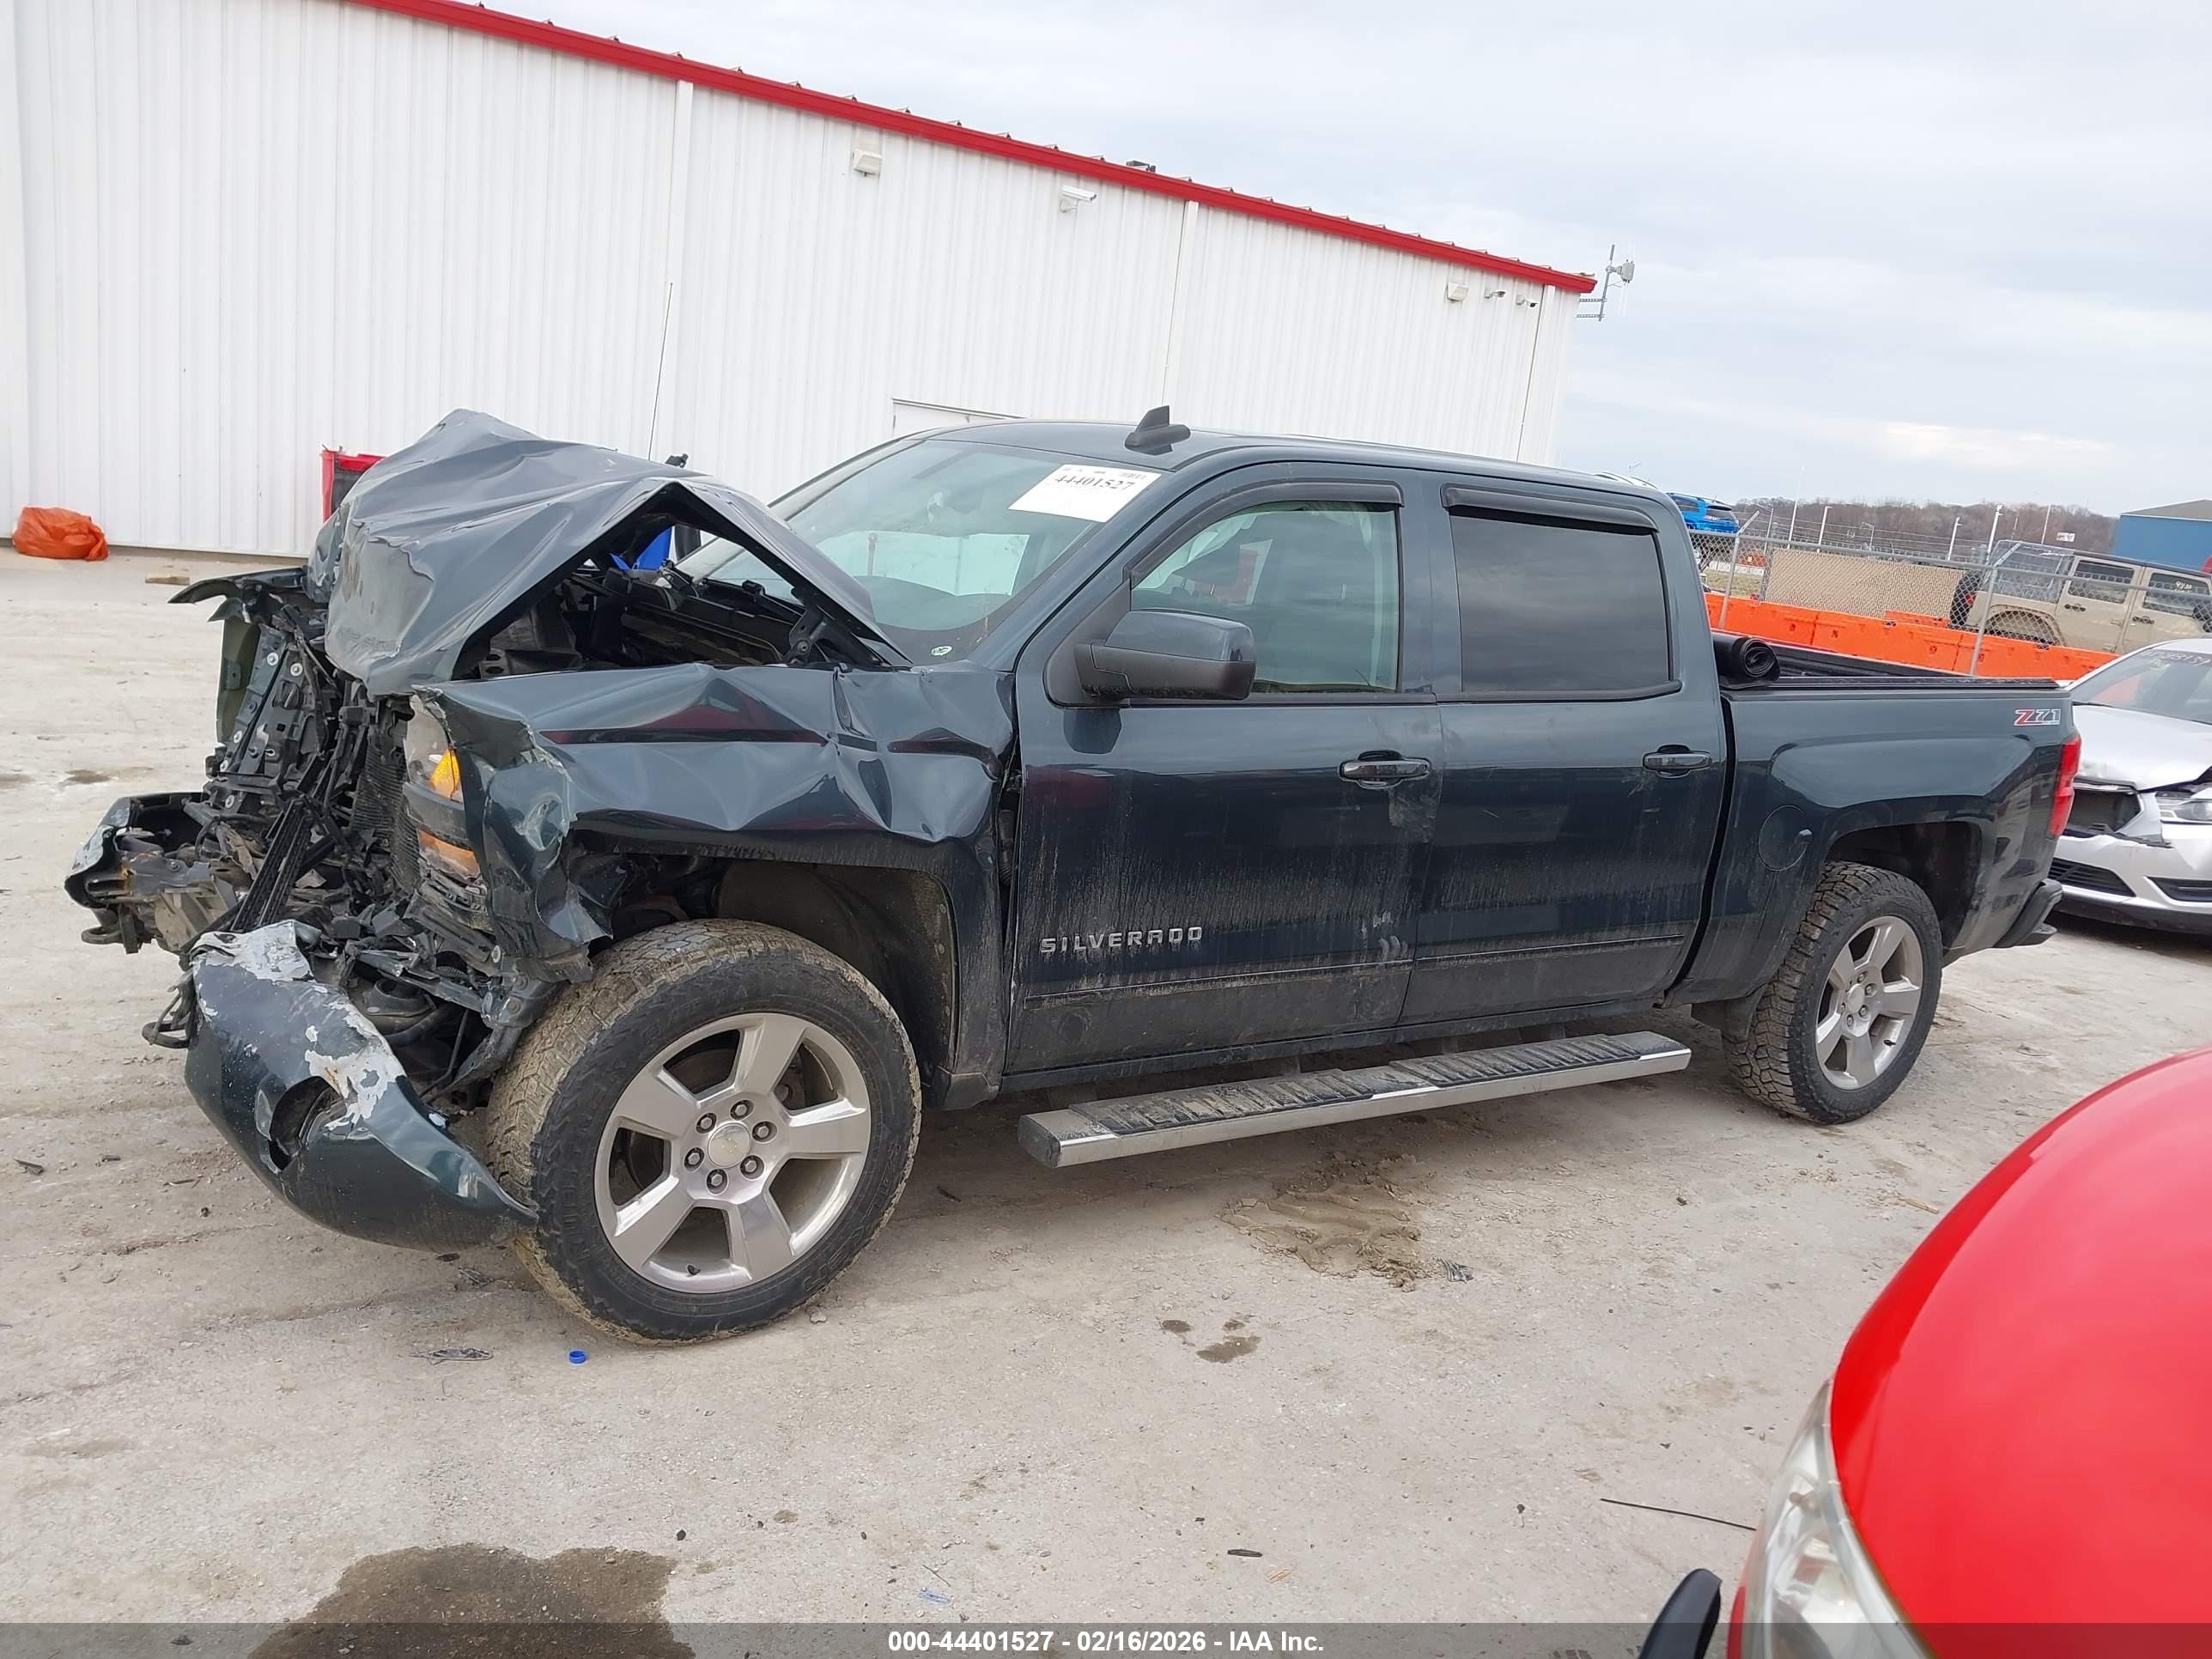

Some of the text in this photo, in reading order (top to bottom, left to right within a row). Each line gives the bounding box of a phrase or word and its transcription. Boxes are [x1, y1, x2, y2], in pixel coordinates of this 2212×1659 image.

[1054, 475, 1135, 490] 44401527
[2014, 708, 2061, 726] Z71
[1041, 927, 1202, 953] SILVERADO
